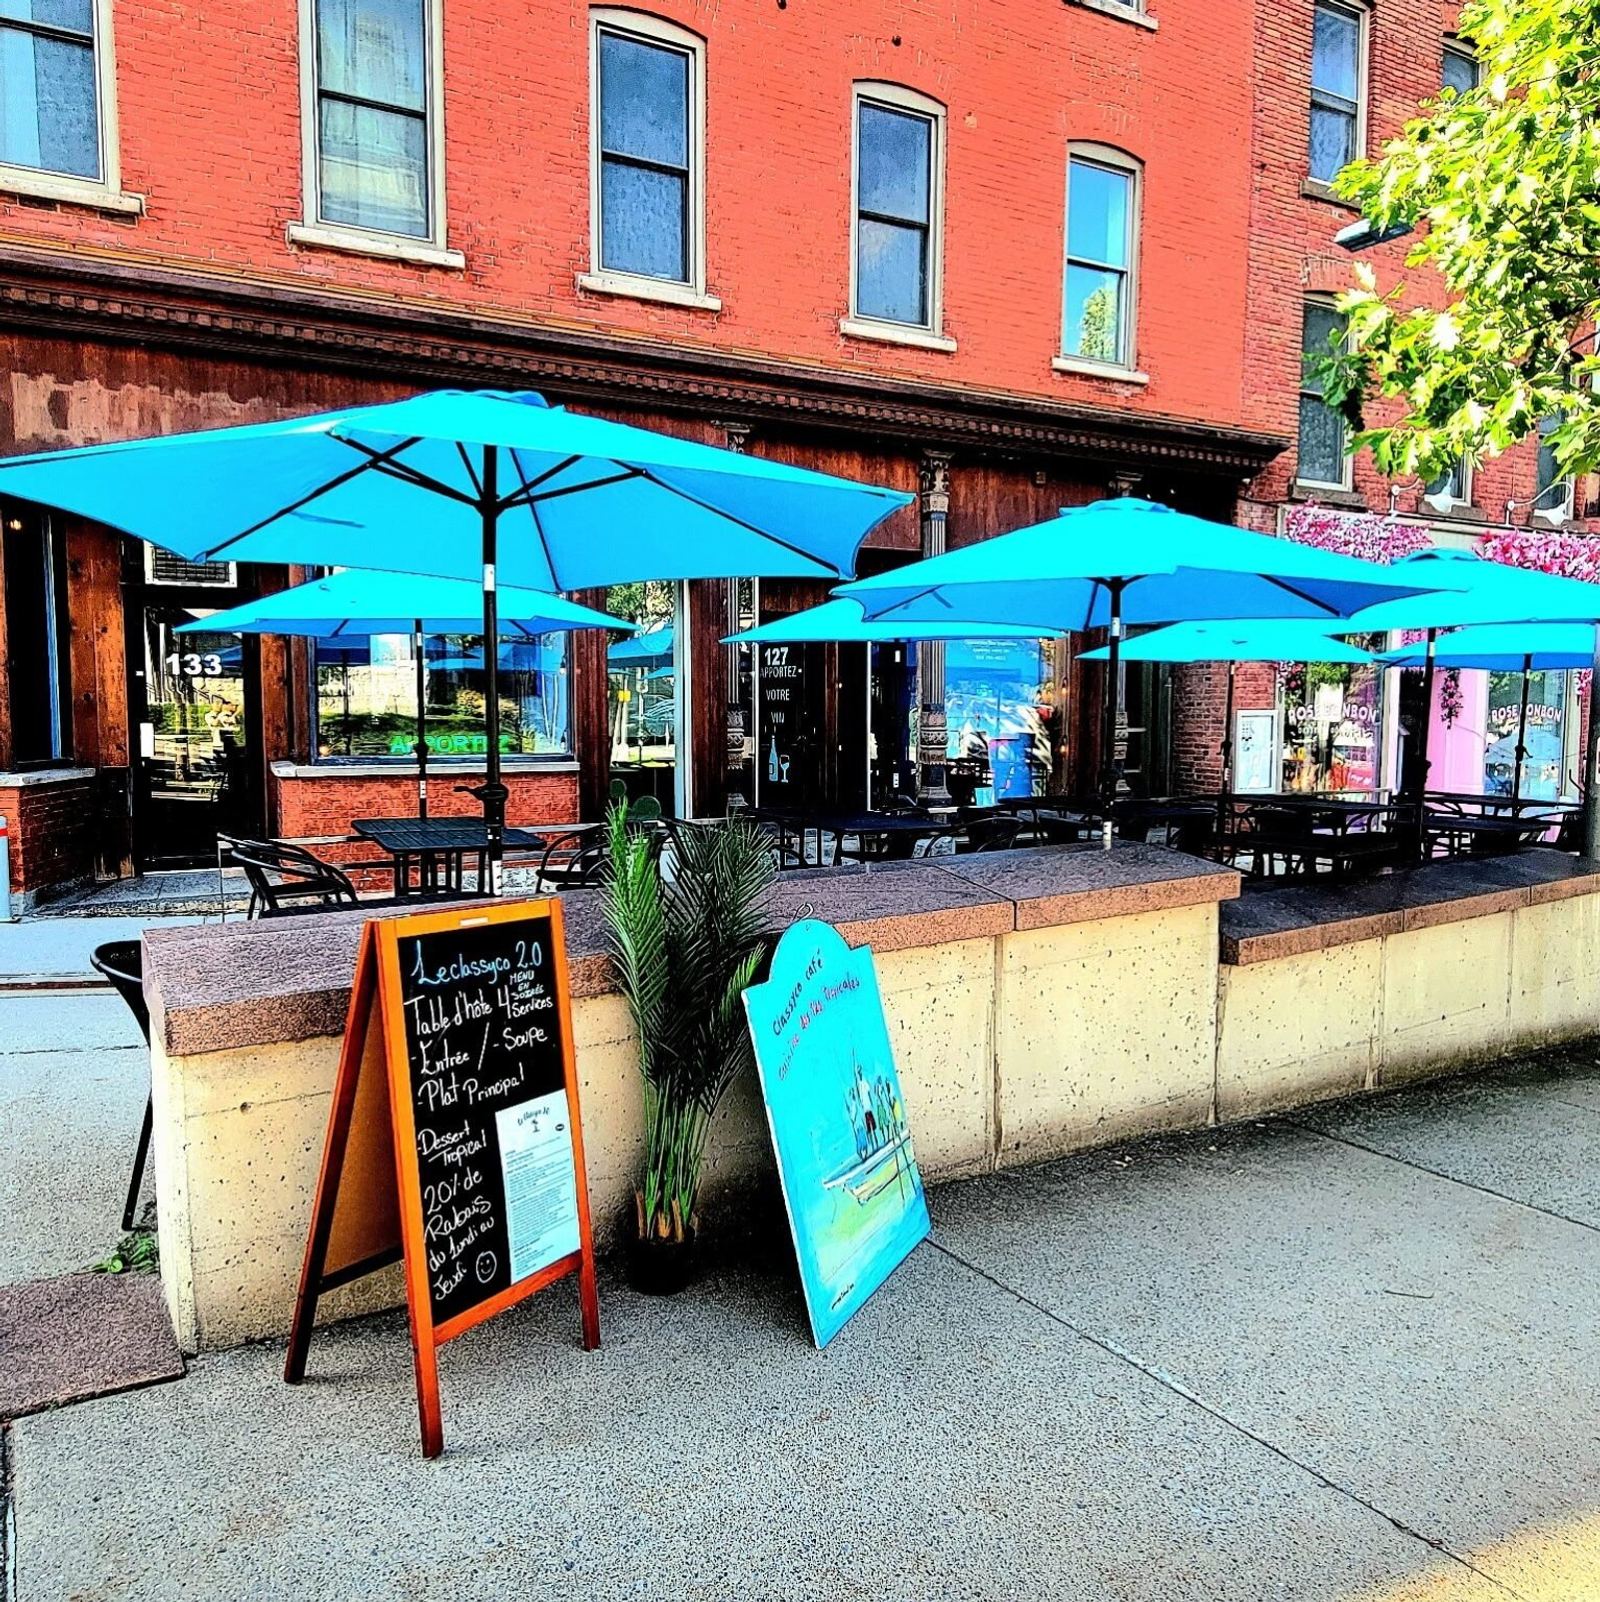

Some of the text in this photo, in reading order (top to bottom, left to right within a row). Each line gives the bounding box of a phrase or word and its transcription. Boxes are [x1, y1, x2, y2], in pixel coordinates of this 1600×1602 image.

[164, 652, 222, 677] 133
[764, 646, 789, 666] 127
[760, 665, 797, 678] APPORTEZ
[765, 688, 790, 701] VOTRE
[771, 711, 785, 724] VIN
[1491, 703, 1562, 723] ROSE ONBON
[515, 940, 542, 968] 2.0
[509, 970, 535, 985] MENU
[518, 982, 530, 992] EN
[403, 995, 450, 1036] Table
[511, 996, 553, 1018] Services
[772, 982, 803, 1036] Classyco
[462, 1061, 525, 1105] Principal
[428, 1128, 487, 1166] Tropical
[463, 1166, 483, 1191] de
[424, 1195, 492, 1244] Rabais
[428, 1250, 447, 1272] du
[480, 1216, 494, 1233] au
[433, 1261, 468, 1301] Jeudi
